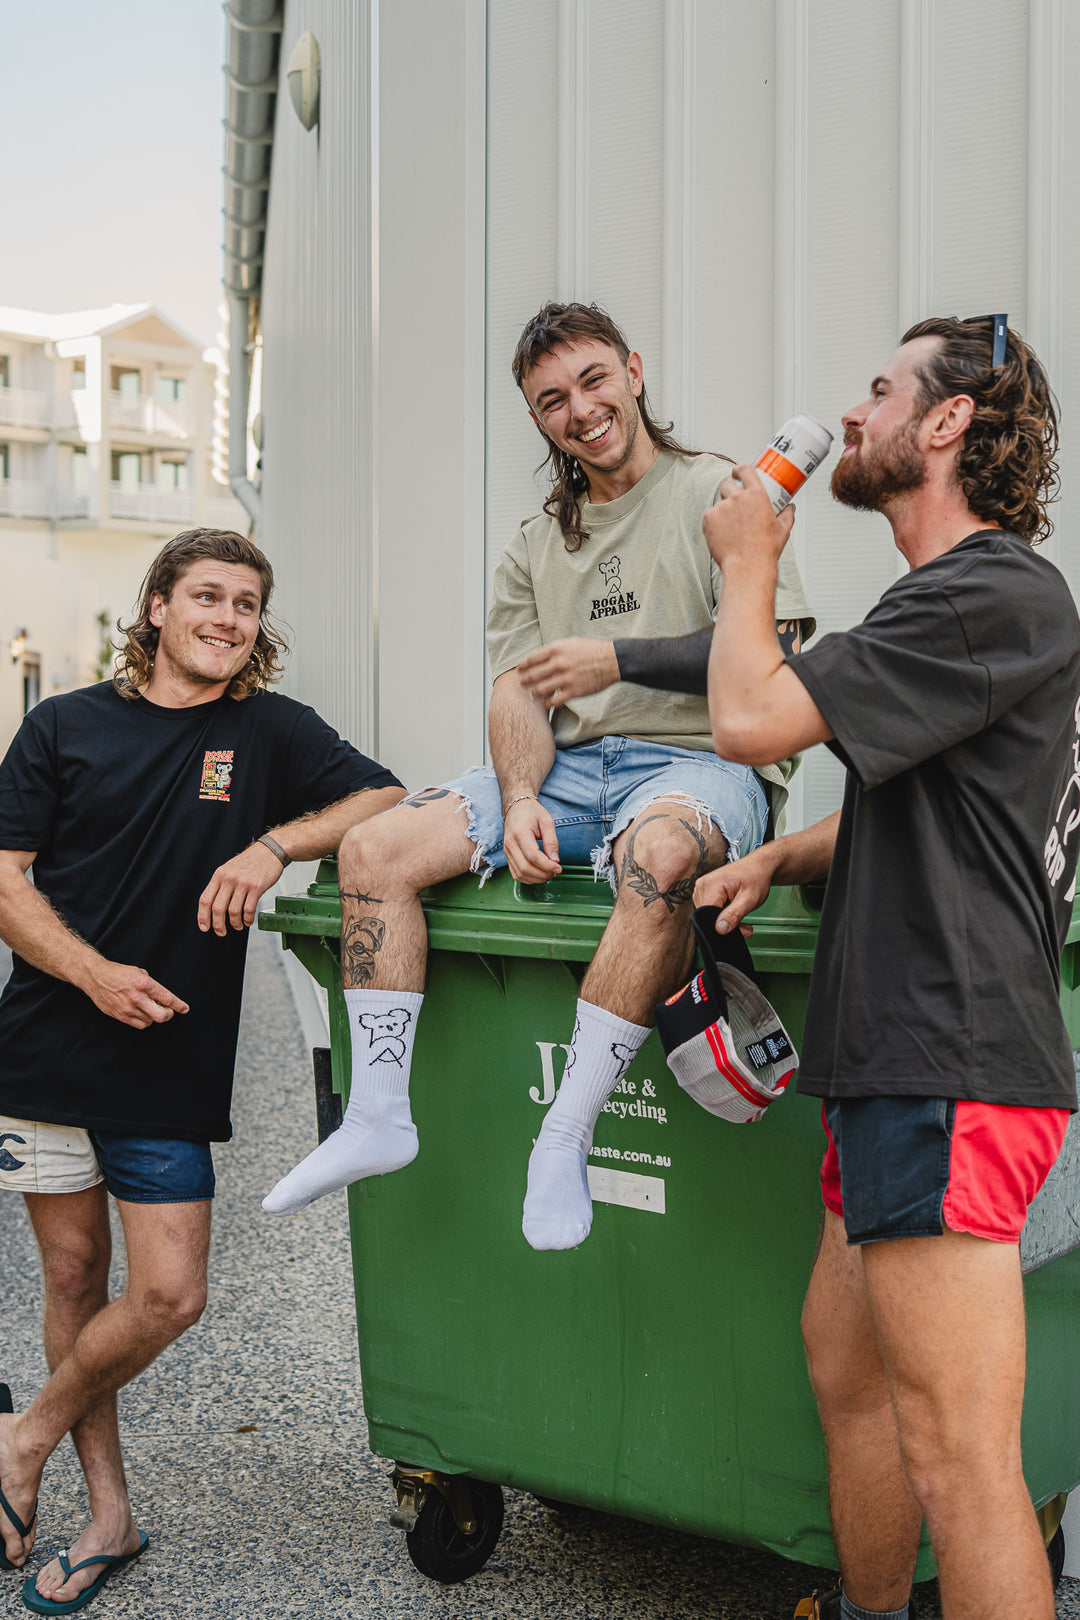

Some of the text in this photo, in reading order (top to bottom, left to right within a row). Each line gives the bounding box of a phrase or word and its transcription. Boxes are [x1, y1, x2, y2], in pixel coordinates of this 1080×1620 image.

[589, 600, 641, 621] APPAREL
[592, 592, 634, 609] BOGAN
[641, 1078, 657, 1098] &
[600, 1099, 668, 1125] ecycling
